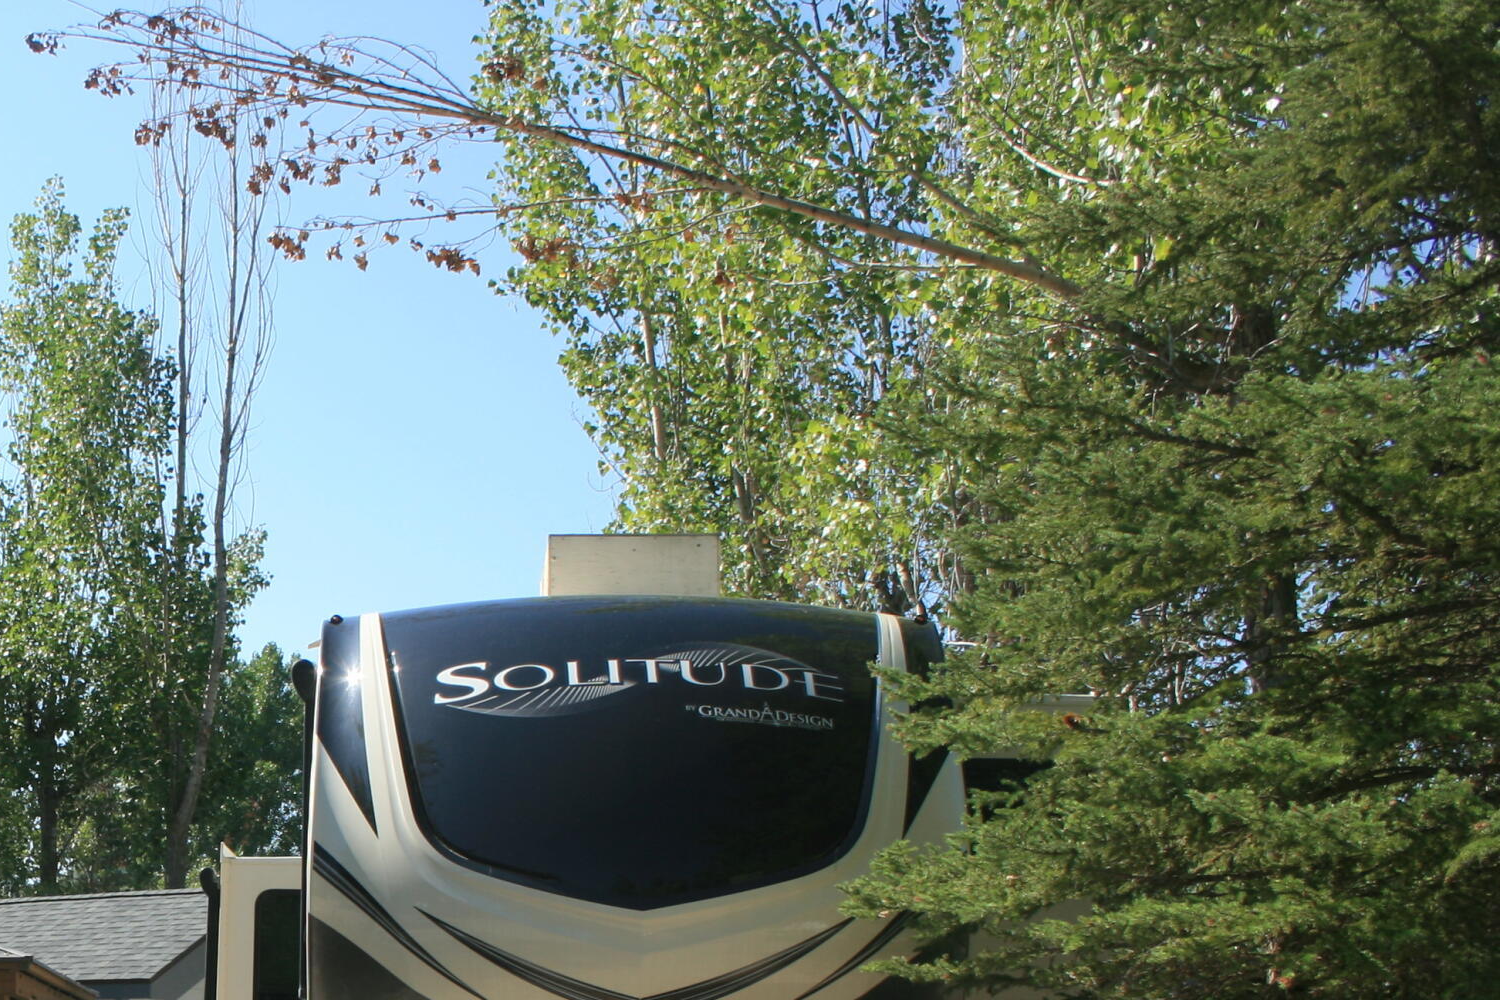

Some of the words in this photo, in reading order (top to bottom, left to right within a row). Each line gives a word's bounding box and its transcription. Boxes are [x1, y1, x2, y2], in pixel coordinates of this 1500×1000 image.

[434, 658, 844, 703] SOLITUDE
[697, 704, 760, 721] GRAND
[776, 710, 834, 729] DESIGN
